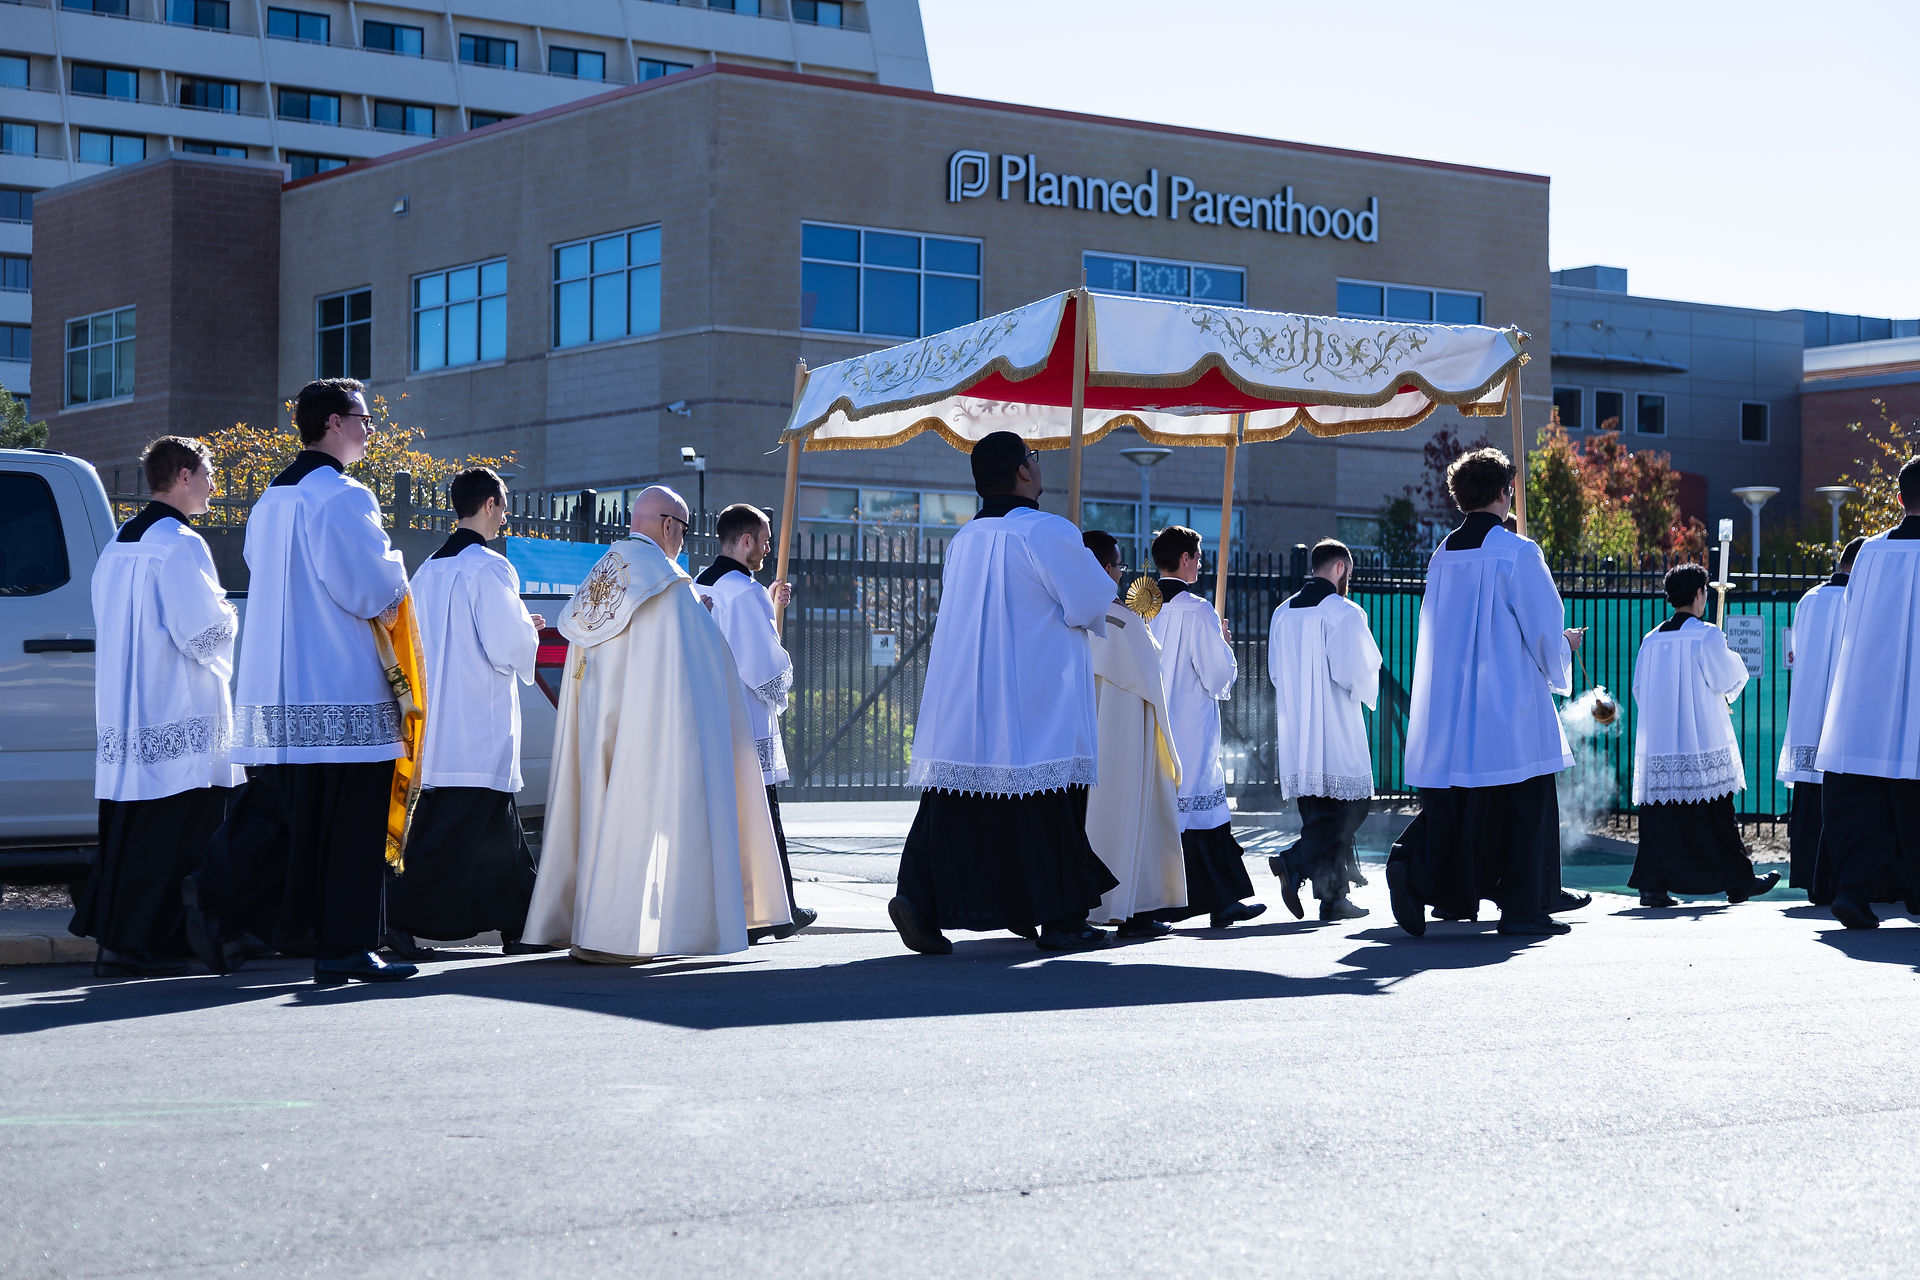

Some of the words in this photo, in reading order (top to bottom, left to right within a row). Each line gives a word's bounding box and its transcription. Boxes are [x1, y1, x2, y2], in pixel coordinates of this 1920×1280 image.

[1001, 154, 1159, 218] Planned
[1169, 175, 1379, 243] Parenthood
[1112, 261, 1212, 298] PROUD
